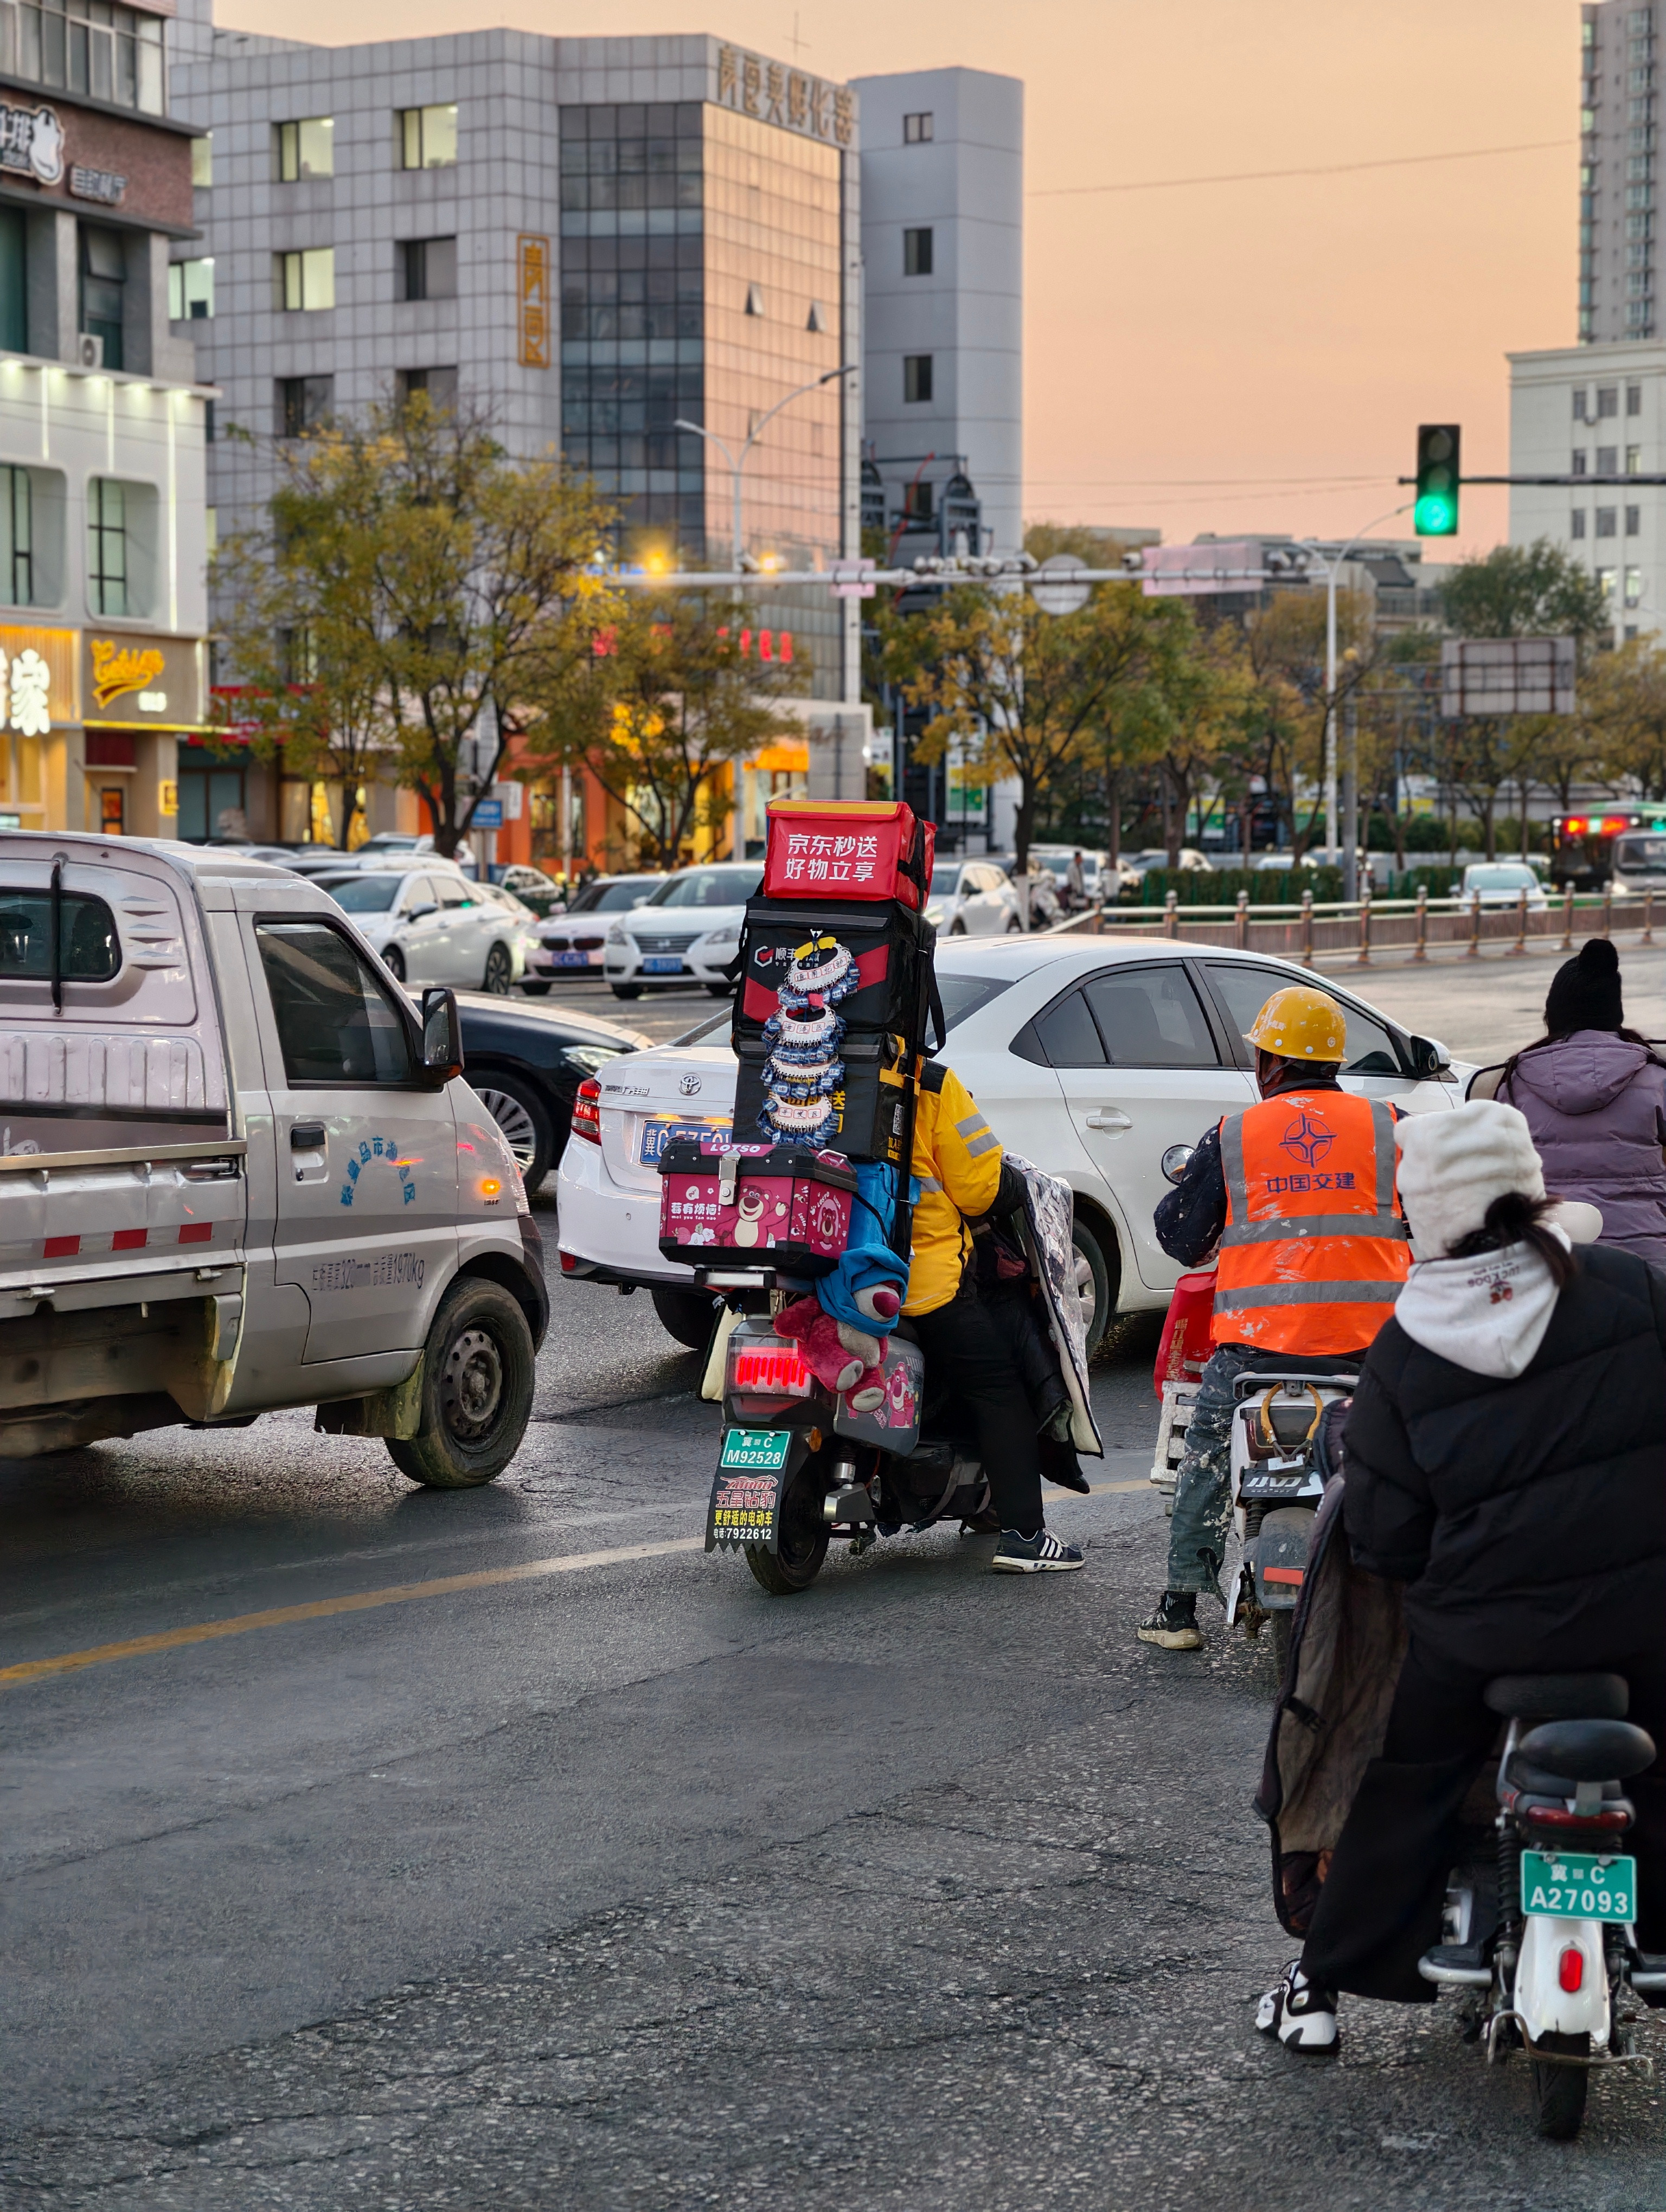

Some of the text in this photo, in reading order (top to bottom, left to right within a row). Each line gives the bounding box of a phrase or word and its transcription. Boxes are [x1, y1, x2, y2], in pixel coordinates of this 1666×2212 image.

[788, 833, 877, 858] 京东秒送
[784, 858, 875, 882] 好物立享
[1267, 1172, 1356, 1194] 中国交建
[727, 1450, 781, 1464] M92528
[716, 1491, 777, 1508] 五星钻豹
[714, 1510, 773, 1526] 更舒适的电动车
[713, 1528, 772, 1539] 电话:7922612
[1530, 1886, 1628, 1914] A27093
